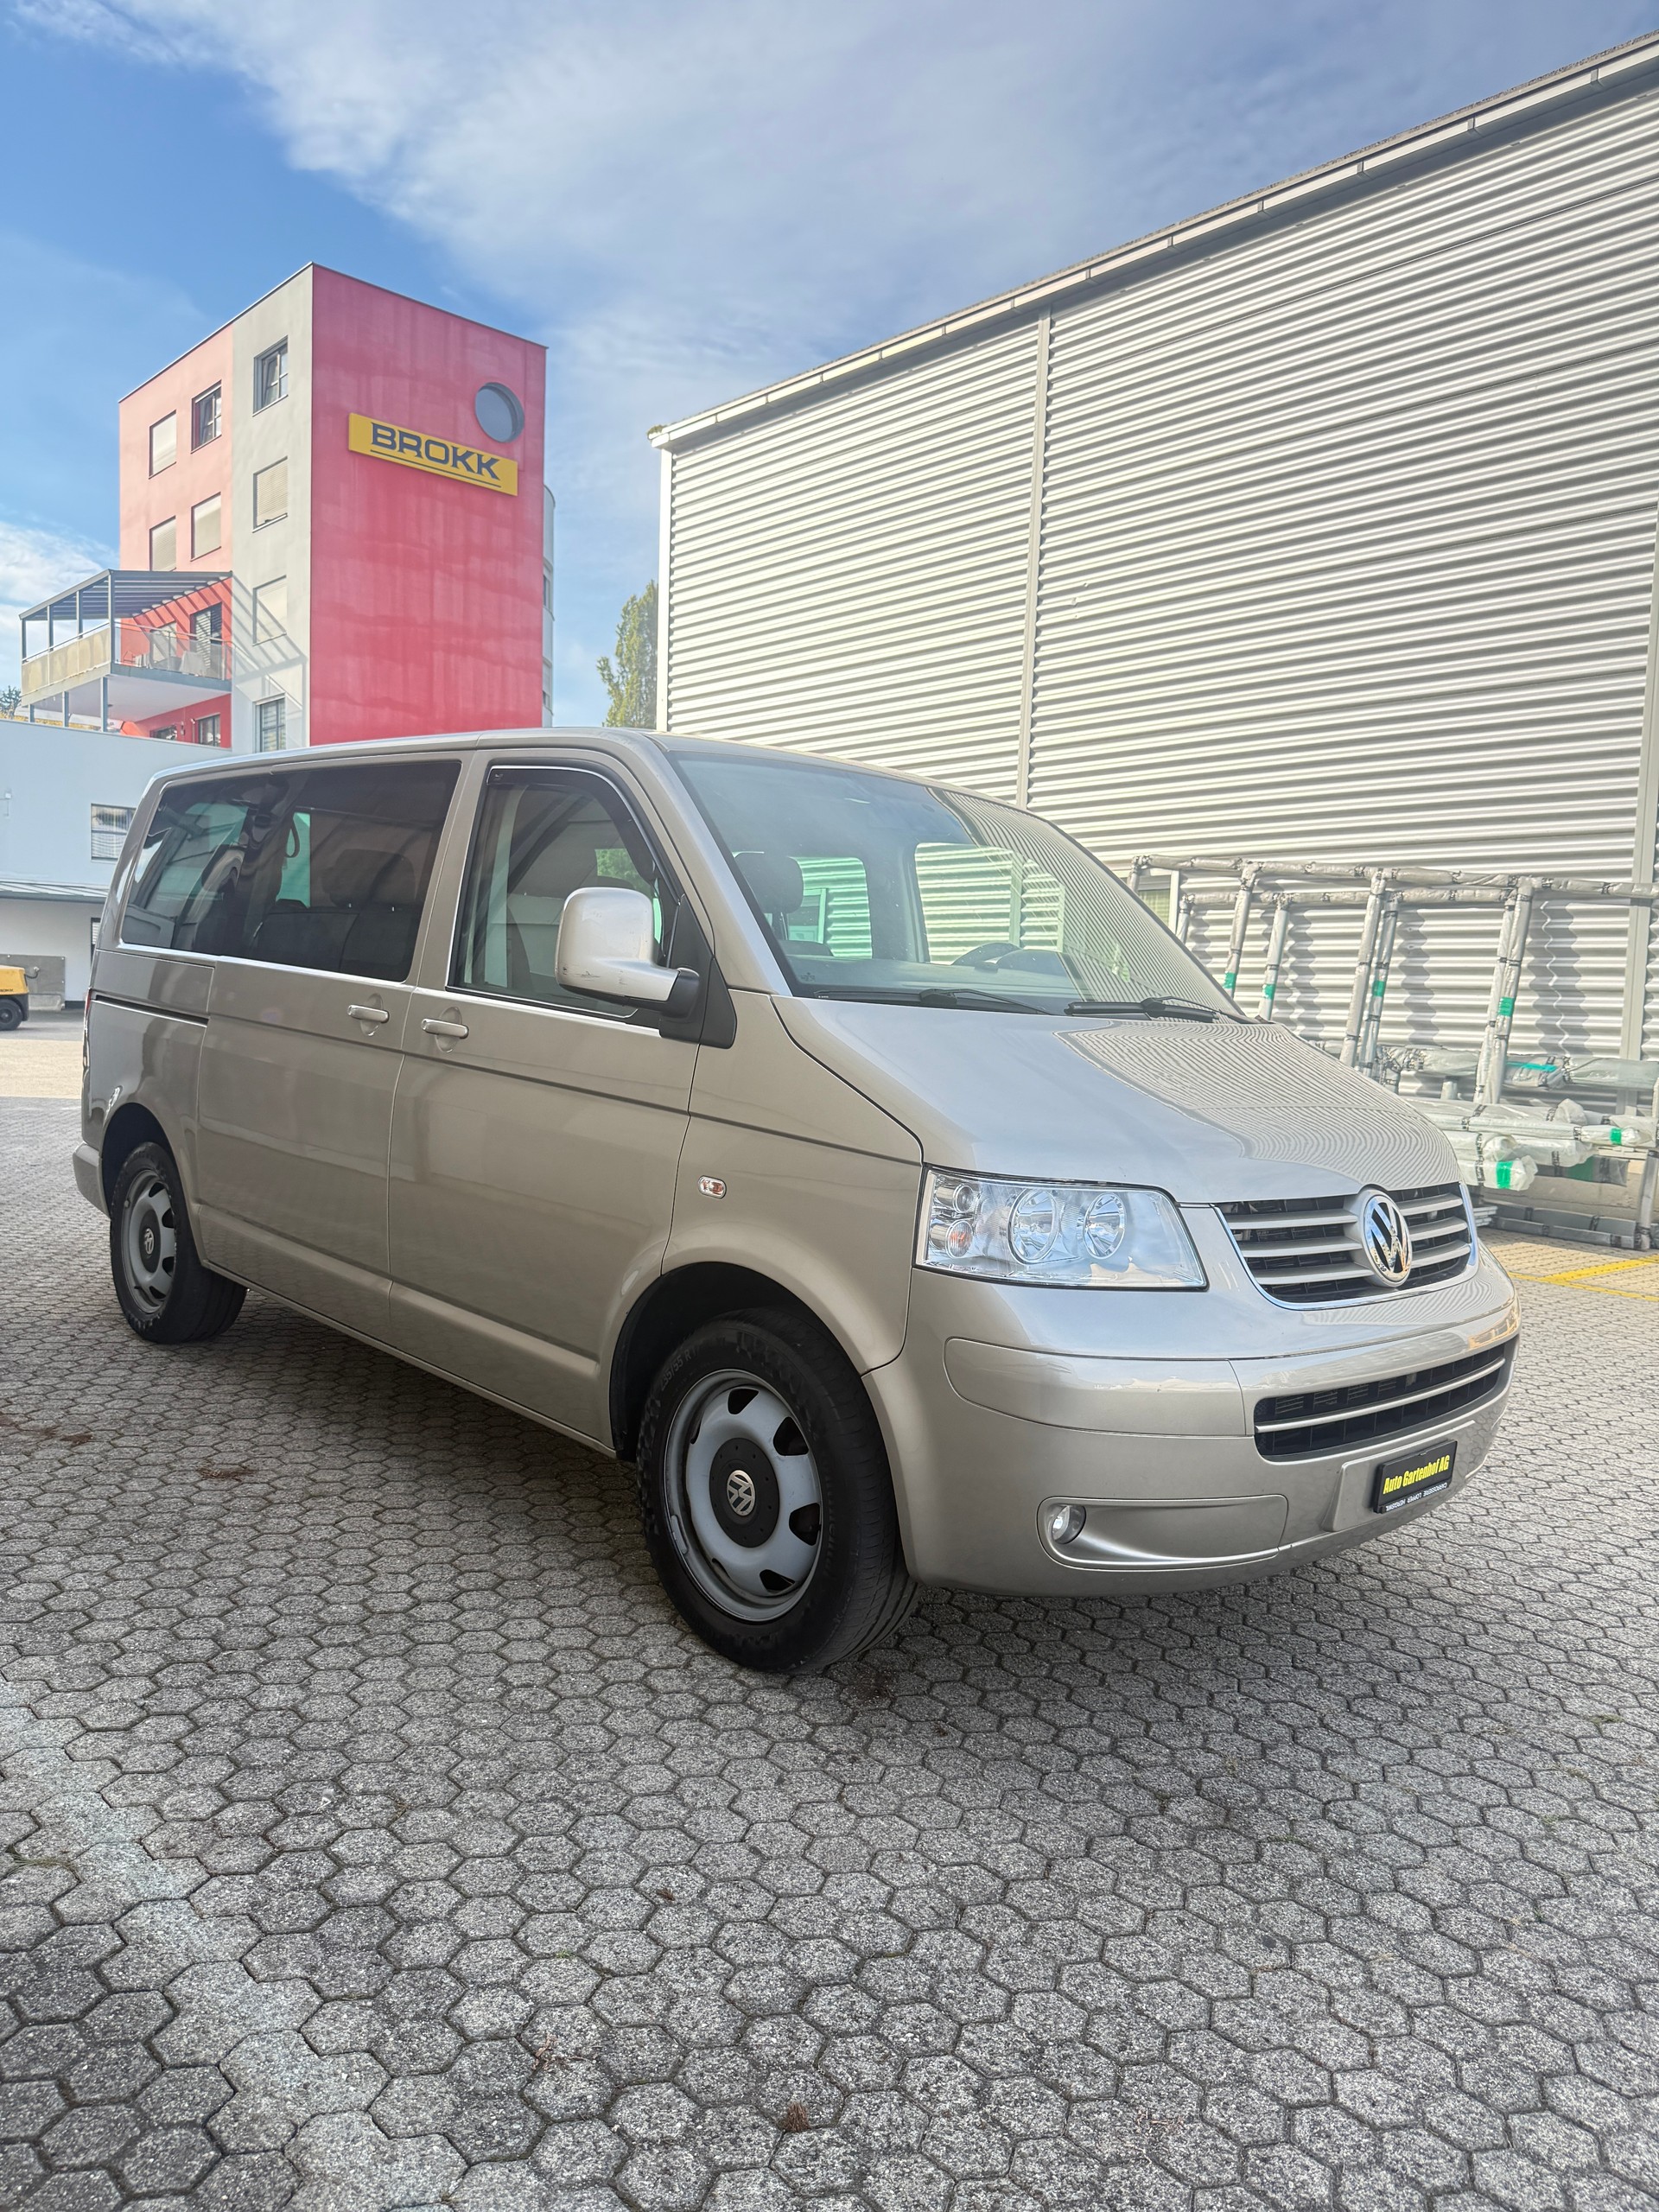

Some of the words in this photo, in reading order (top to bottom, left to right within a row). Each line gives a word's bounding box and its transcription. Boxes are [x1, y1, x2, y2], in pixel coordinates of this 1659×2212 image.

[371, 422, 500, 480] BROKK
[727, 1470, 755, 1516] VW
[1382, 1475, 1403, 1495] Auto
[1402, 1458, 1440, 1487] Gartenhof
[1439, 1454, 1451, 1473] AG
